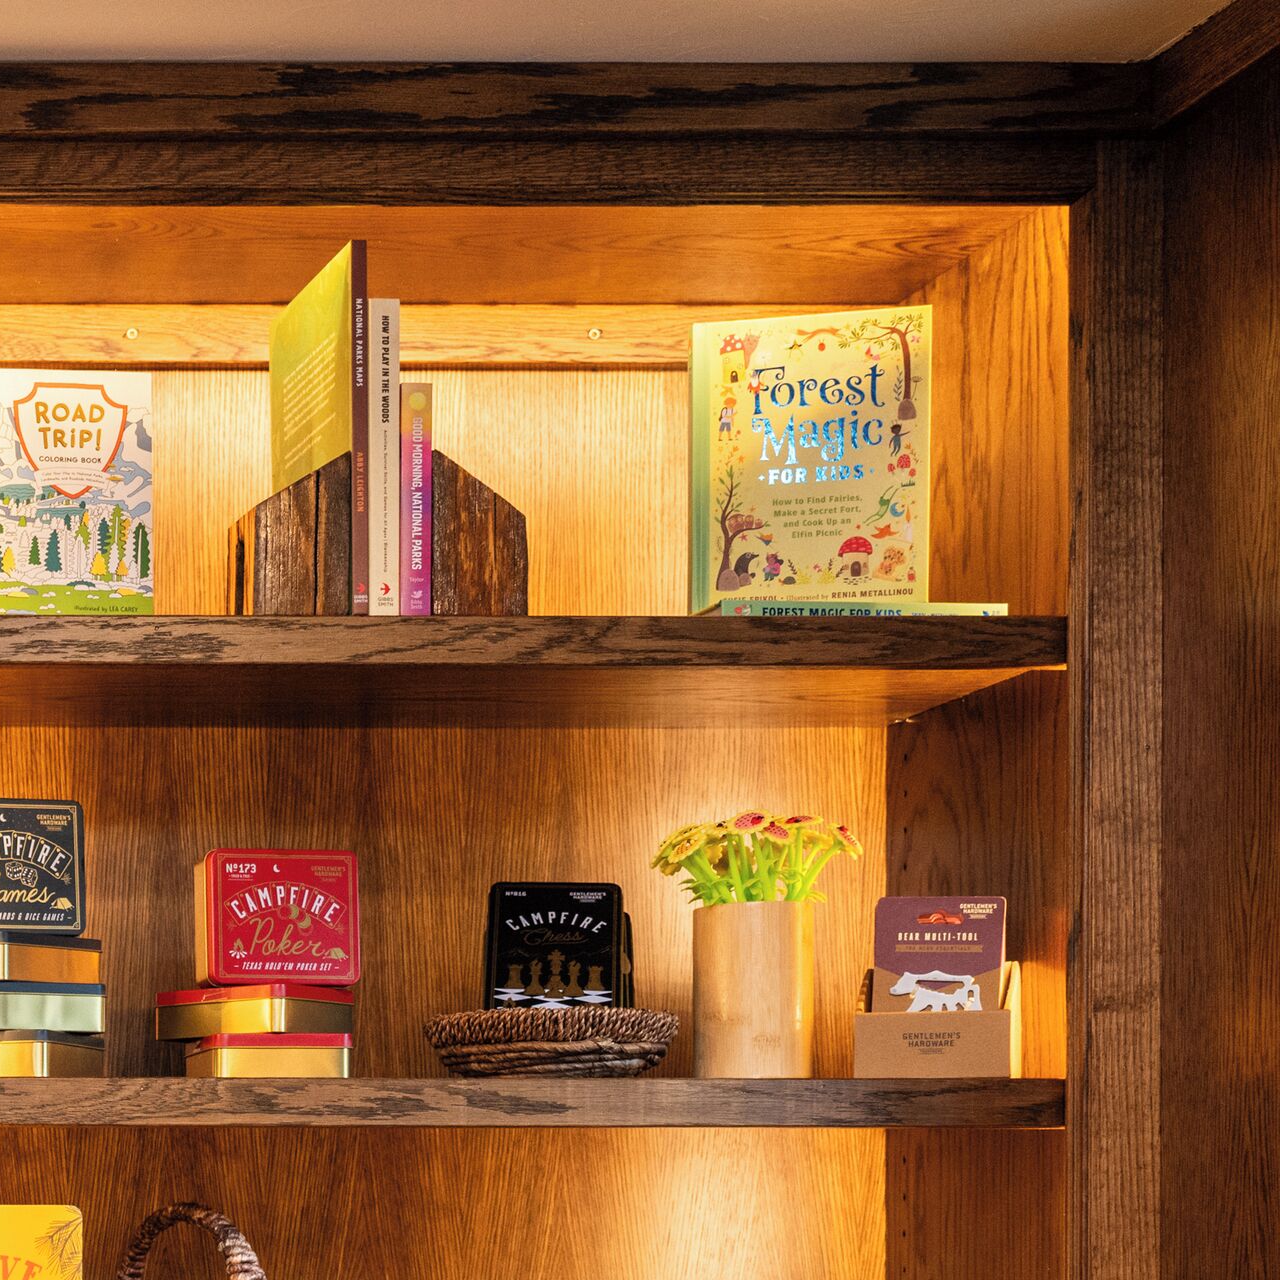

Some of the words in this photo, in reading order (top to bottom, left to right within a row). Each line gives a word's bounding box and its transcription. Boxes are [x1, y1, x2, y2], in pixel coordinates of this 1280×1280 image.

[355, 298, 363, 337] NATIONAL
[382, 335, 389, 345] TO
[355, 340, 363, 366] PARKS
[356, 367, 364, 387] MAPS
[382, 367, 389, 377] IN
[751, 363, 885, 415] Forest
[34, 401, 105, 424] ROAD
[382, 395, 390, 424] WOODS
[412, 417, 423, 442] GOOD
[751, 410, 883, 466] Magic
[411, 444, 423, 491] MORNING,
[767, 466, 808, 486] FOR
[815, 464, 864, 482] KIDS
[795, 497, 804, 505] to
[807, 496, 826, 504] Find
[809, 507, 837, 515] Secret
[411, 492, 423, 536] NATIONAL
[783, 520, 799, 528] and
[802, 519, 824, 527] Cook
[826, 518, 838, 526] Up
[792, 530, 813, 539] Elfin
[816, 529, 843, 537] Picnic
[411, 540, 422, 570] PARKS
[860, 588, 914, 597] METALLINOU
[230, 885, 340, 923] CAMPFIRE
[42, 913, 64, 921] GAMES
[505, 911, 607, 933] CAMPFIRE
[250, 917, 326, 956] Poker
[898, 932, 920, 941] BEAR
[924, 932, 978, 941] MULTI-TOOL
[242, 962, 262, 970] TEXAS
[296, 962, 317, 970] POKER
[320, 962, 332, 970] SET
[902, 1032, 961, 1041] GENTLEMEN'S
[908, 1040, 954, 1048] HARDWARE
